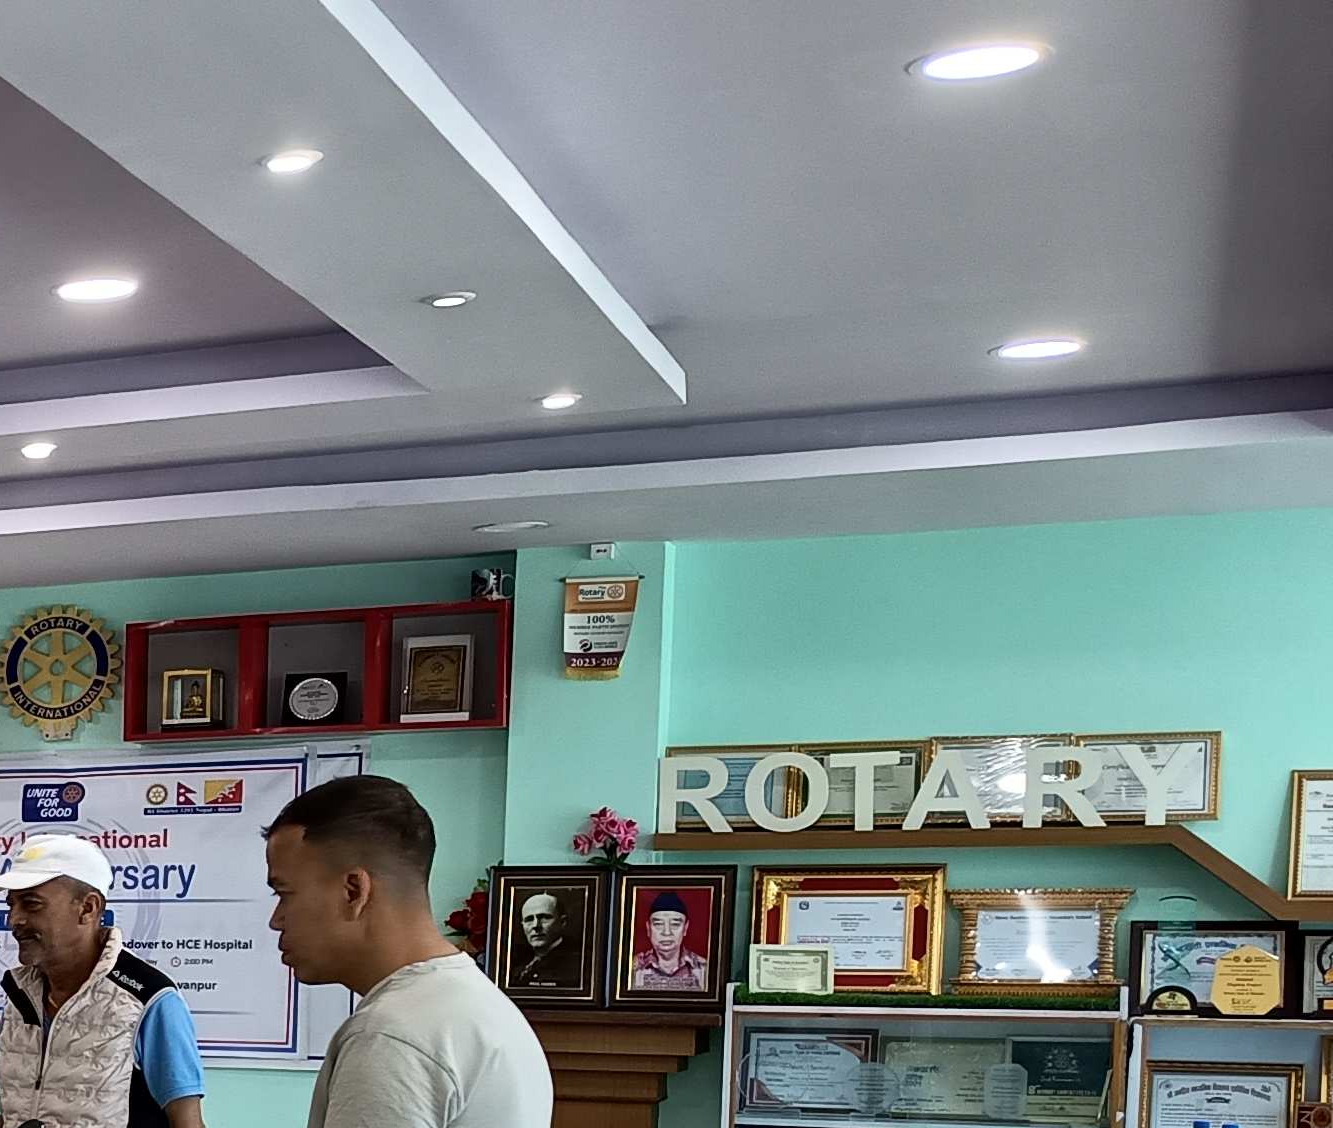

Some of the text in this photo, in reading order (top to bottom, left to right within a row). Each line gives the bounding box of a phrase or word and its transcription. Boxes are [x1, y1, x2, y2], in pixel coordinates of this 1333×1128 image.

[579, 588, 605, 597] Rotary
[586, 615, 616, 624] 100%
[31, 618, 83, 636] ROTARY
[14, 684, 102, 719] INTERNATIONAL
[26, 788, 59, 799] UNITE
[658, 742, 1203, 834] ROTARY
[37, 798, 60, 808] FOR
[40, 807, 73, 818] GOOD
[161, 940, 174, 950] to
[176, 939, 201, 950] HCE
[204, 939, 253, 952] Hospital
